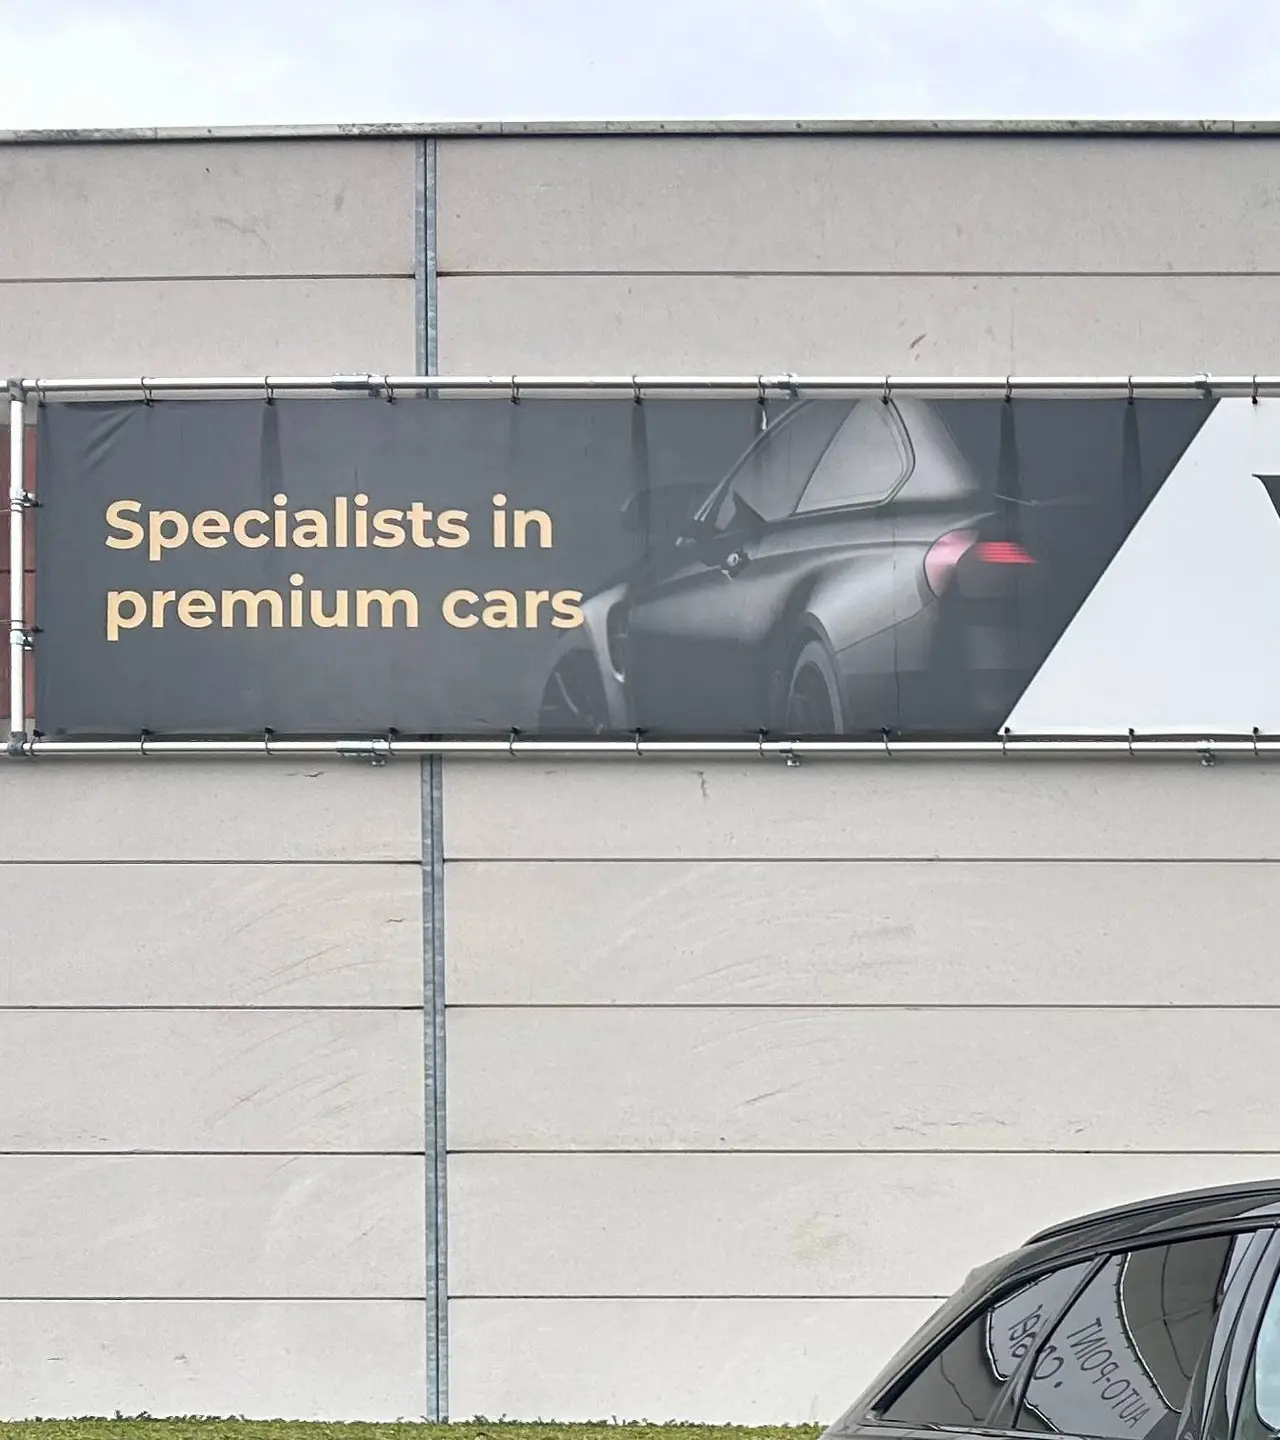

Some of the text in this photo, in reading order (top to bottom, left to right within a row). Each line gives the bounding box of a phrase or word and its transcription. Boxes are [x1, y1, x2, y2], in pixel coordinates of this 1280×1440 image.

[105, 492, 553, 561] Specialists in
[105, 574, 585, 641] premium cars
